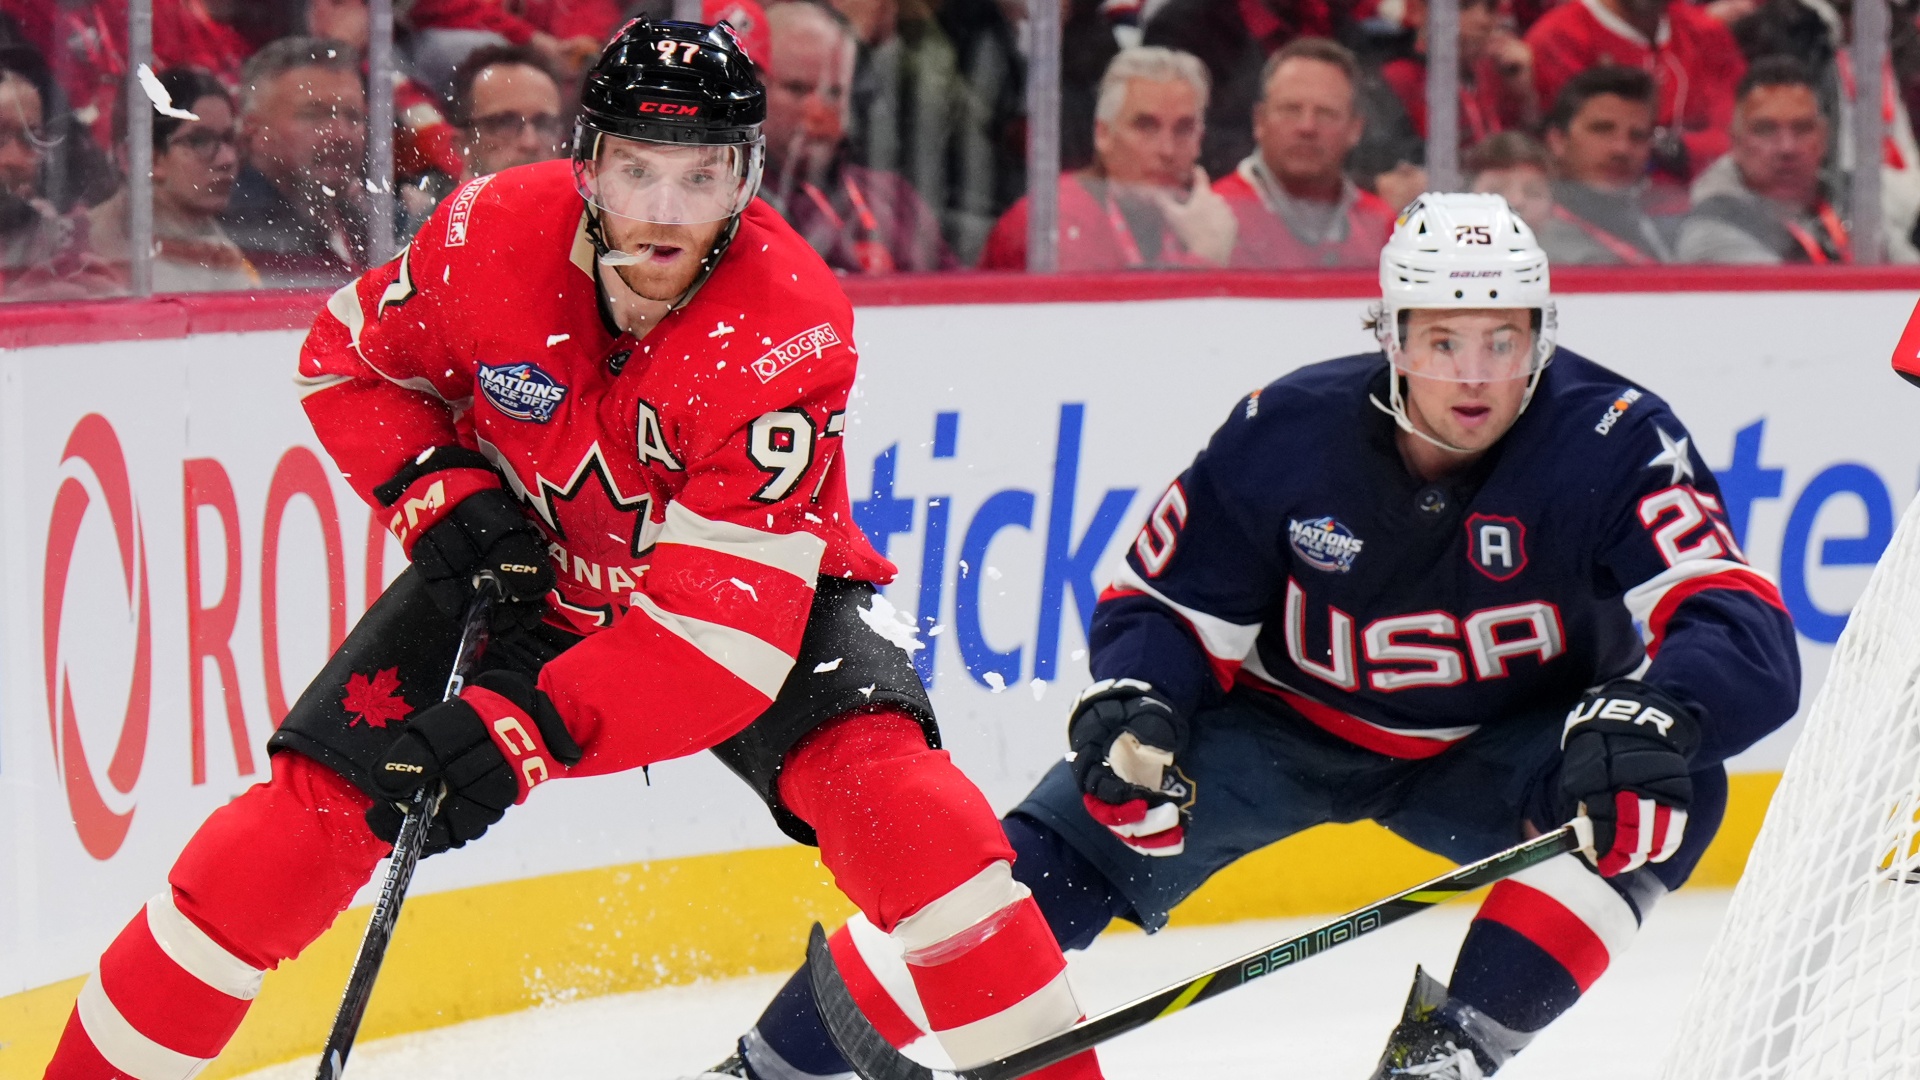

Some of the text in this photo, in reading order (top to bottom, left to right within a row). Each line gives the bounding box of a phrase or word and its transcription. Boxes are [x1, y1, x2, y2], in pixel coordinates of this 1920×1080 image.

[656, 40, 700, 64] 97
[639, 102, 698, 116] CCM
[1455, 226, 1492, 245] 25
[774, 327, 835, 365] ROGERS
[479, 365, 565, 401] NATIONS
[483, 380, 552, 409] FACE-OFF
[637, 397, 686, 472] A
[1288, 518, 1364, 553] NATIONS
[1480, 525, 1513, 568] A
[1710, 416, 1920, 645] te
[500, 563, 537, 575] CCM
[183, 445, 390, 787] RO
[1283, 575, 1567, 693] USA
[384, 761, 423, 774] CCM
